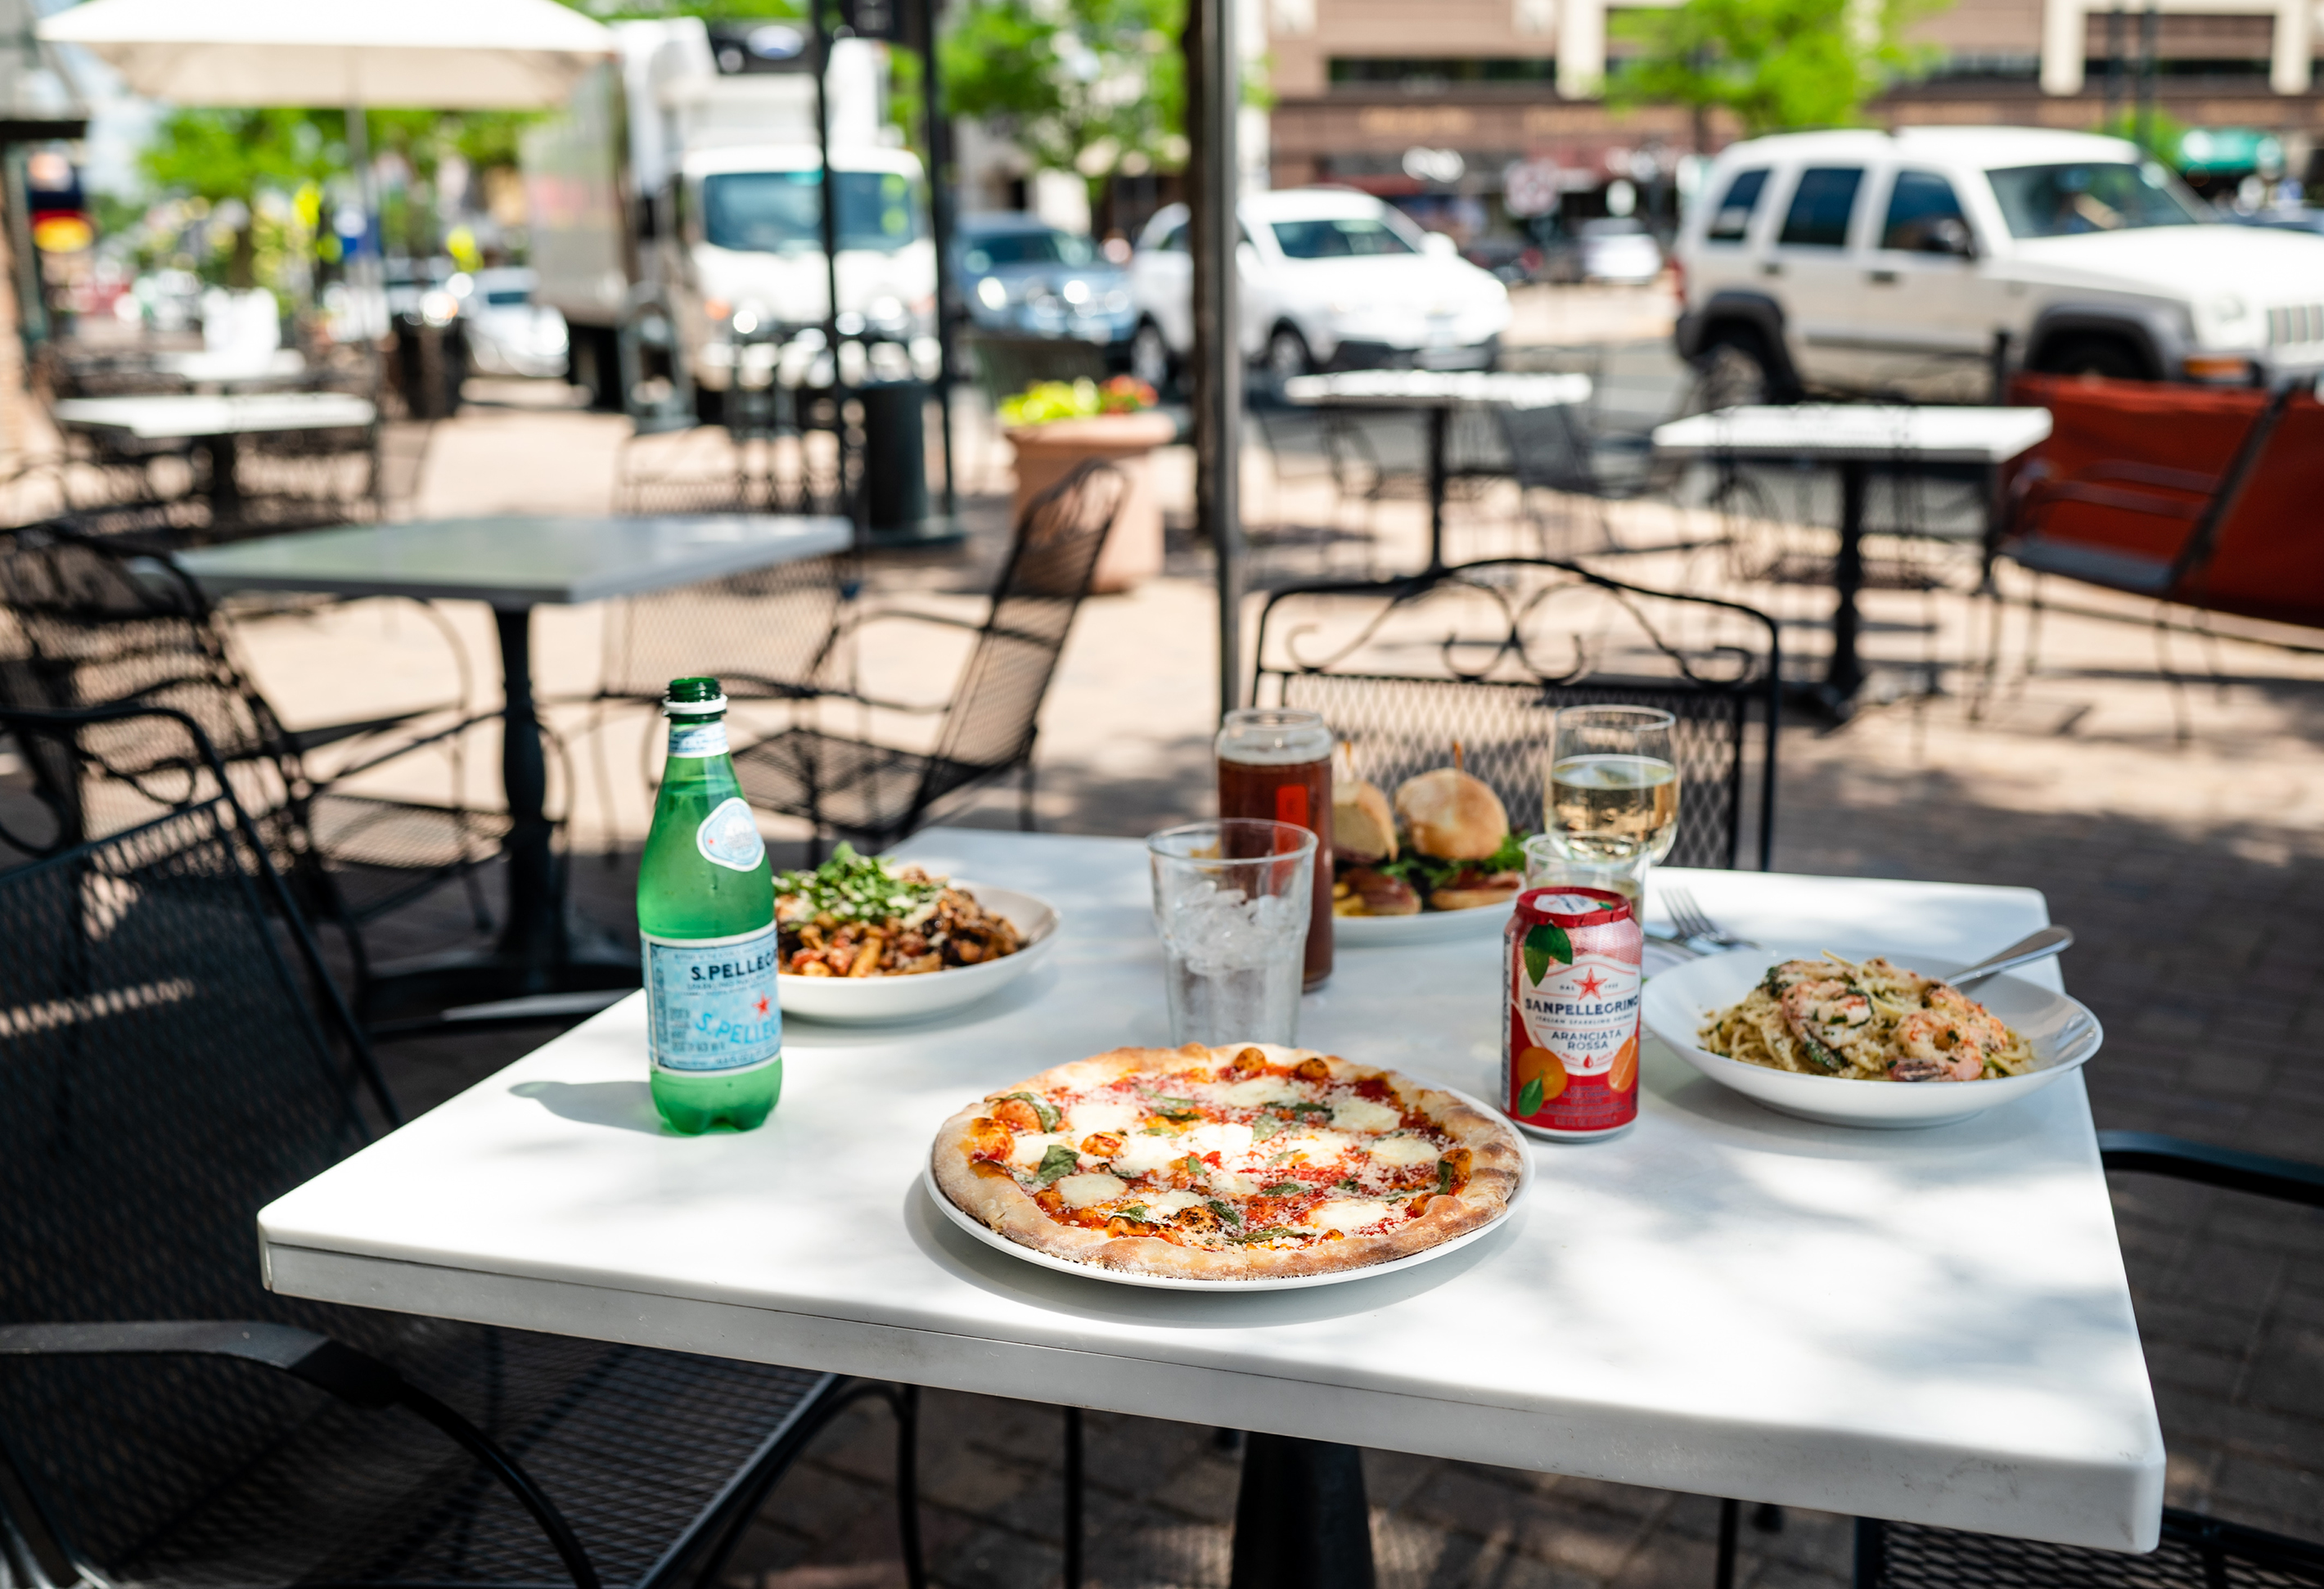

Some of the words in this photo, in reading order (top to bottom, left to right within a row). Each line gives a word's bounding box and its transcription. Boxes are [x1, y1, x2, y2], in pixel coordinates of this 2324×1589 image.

[1525, 995, 1638, 1015] SANPELLEGRINO
[1551, 1029, 1622, 1041] ARANCIATA
[1567, 1040, 1609, 1051] ROSSA
